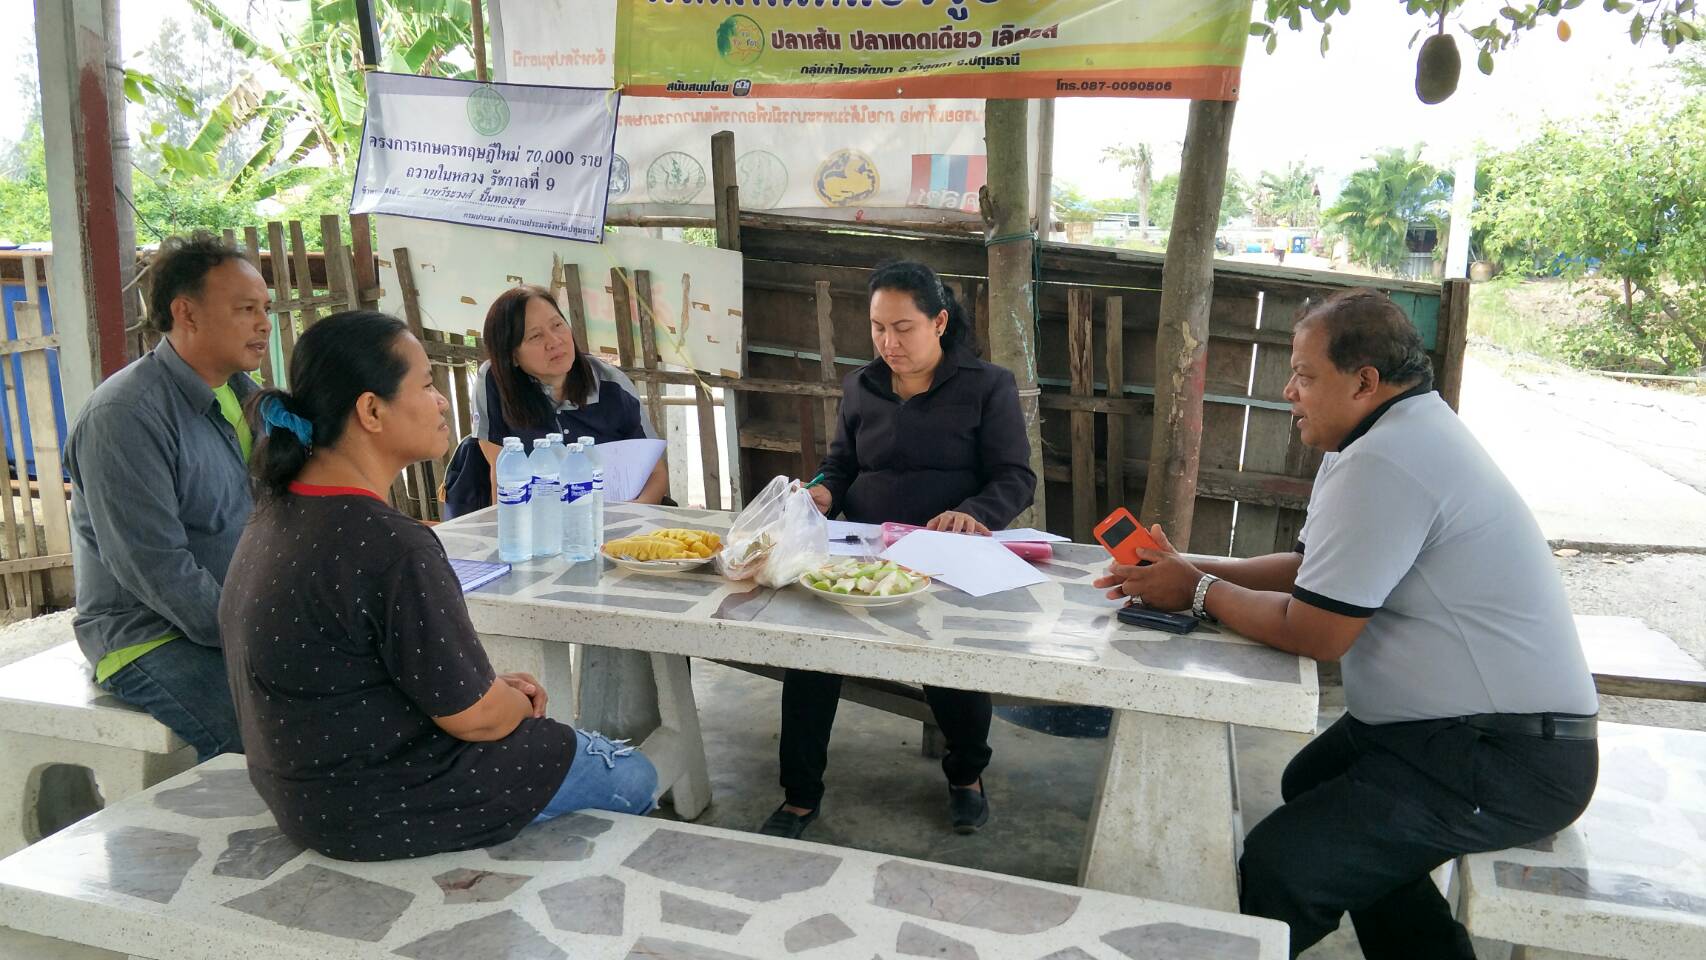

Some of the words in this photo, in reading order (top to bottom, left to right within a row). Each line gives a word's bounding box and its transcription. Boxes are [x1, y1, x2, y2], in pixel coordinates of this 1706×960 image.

[772, 26, 841, 51] ปลาเส้น
[850, 24, 982, 51] ปลาแดดเดียว
[666, 81, 729, 93] สนับสนุนโดย
[368, 134, 521, 164] ครงการเกษตรทฤษฎีใหม่
[526, 149, 574, 166] 70,000
[580, 154, 603, 168] ราย
[406, 164, 484, 185] ถวายในหลวง
[490, 166, 541, 191] รัชกาลที่
[546, 176, 556, 191] 9
